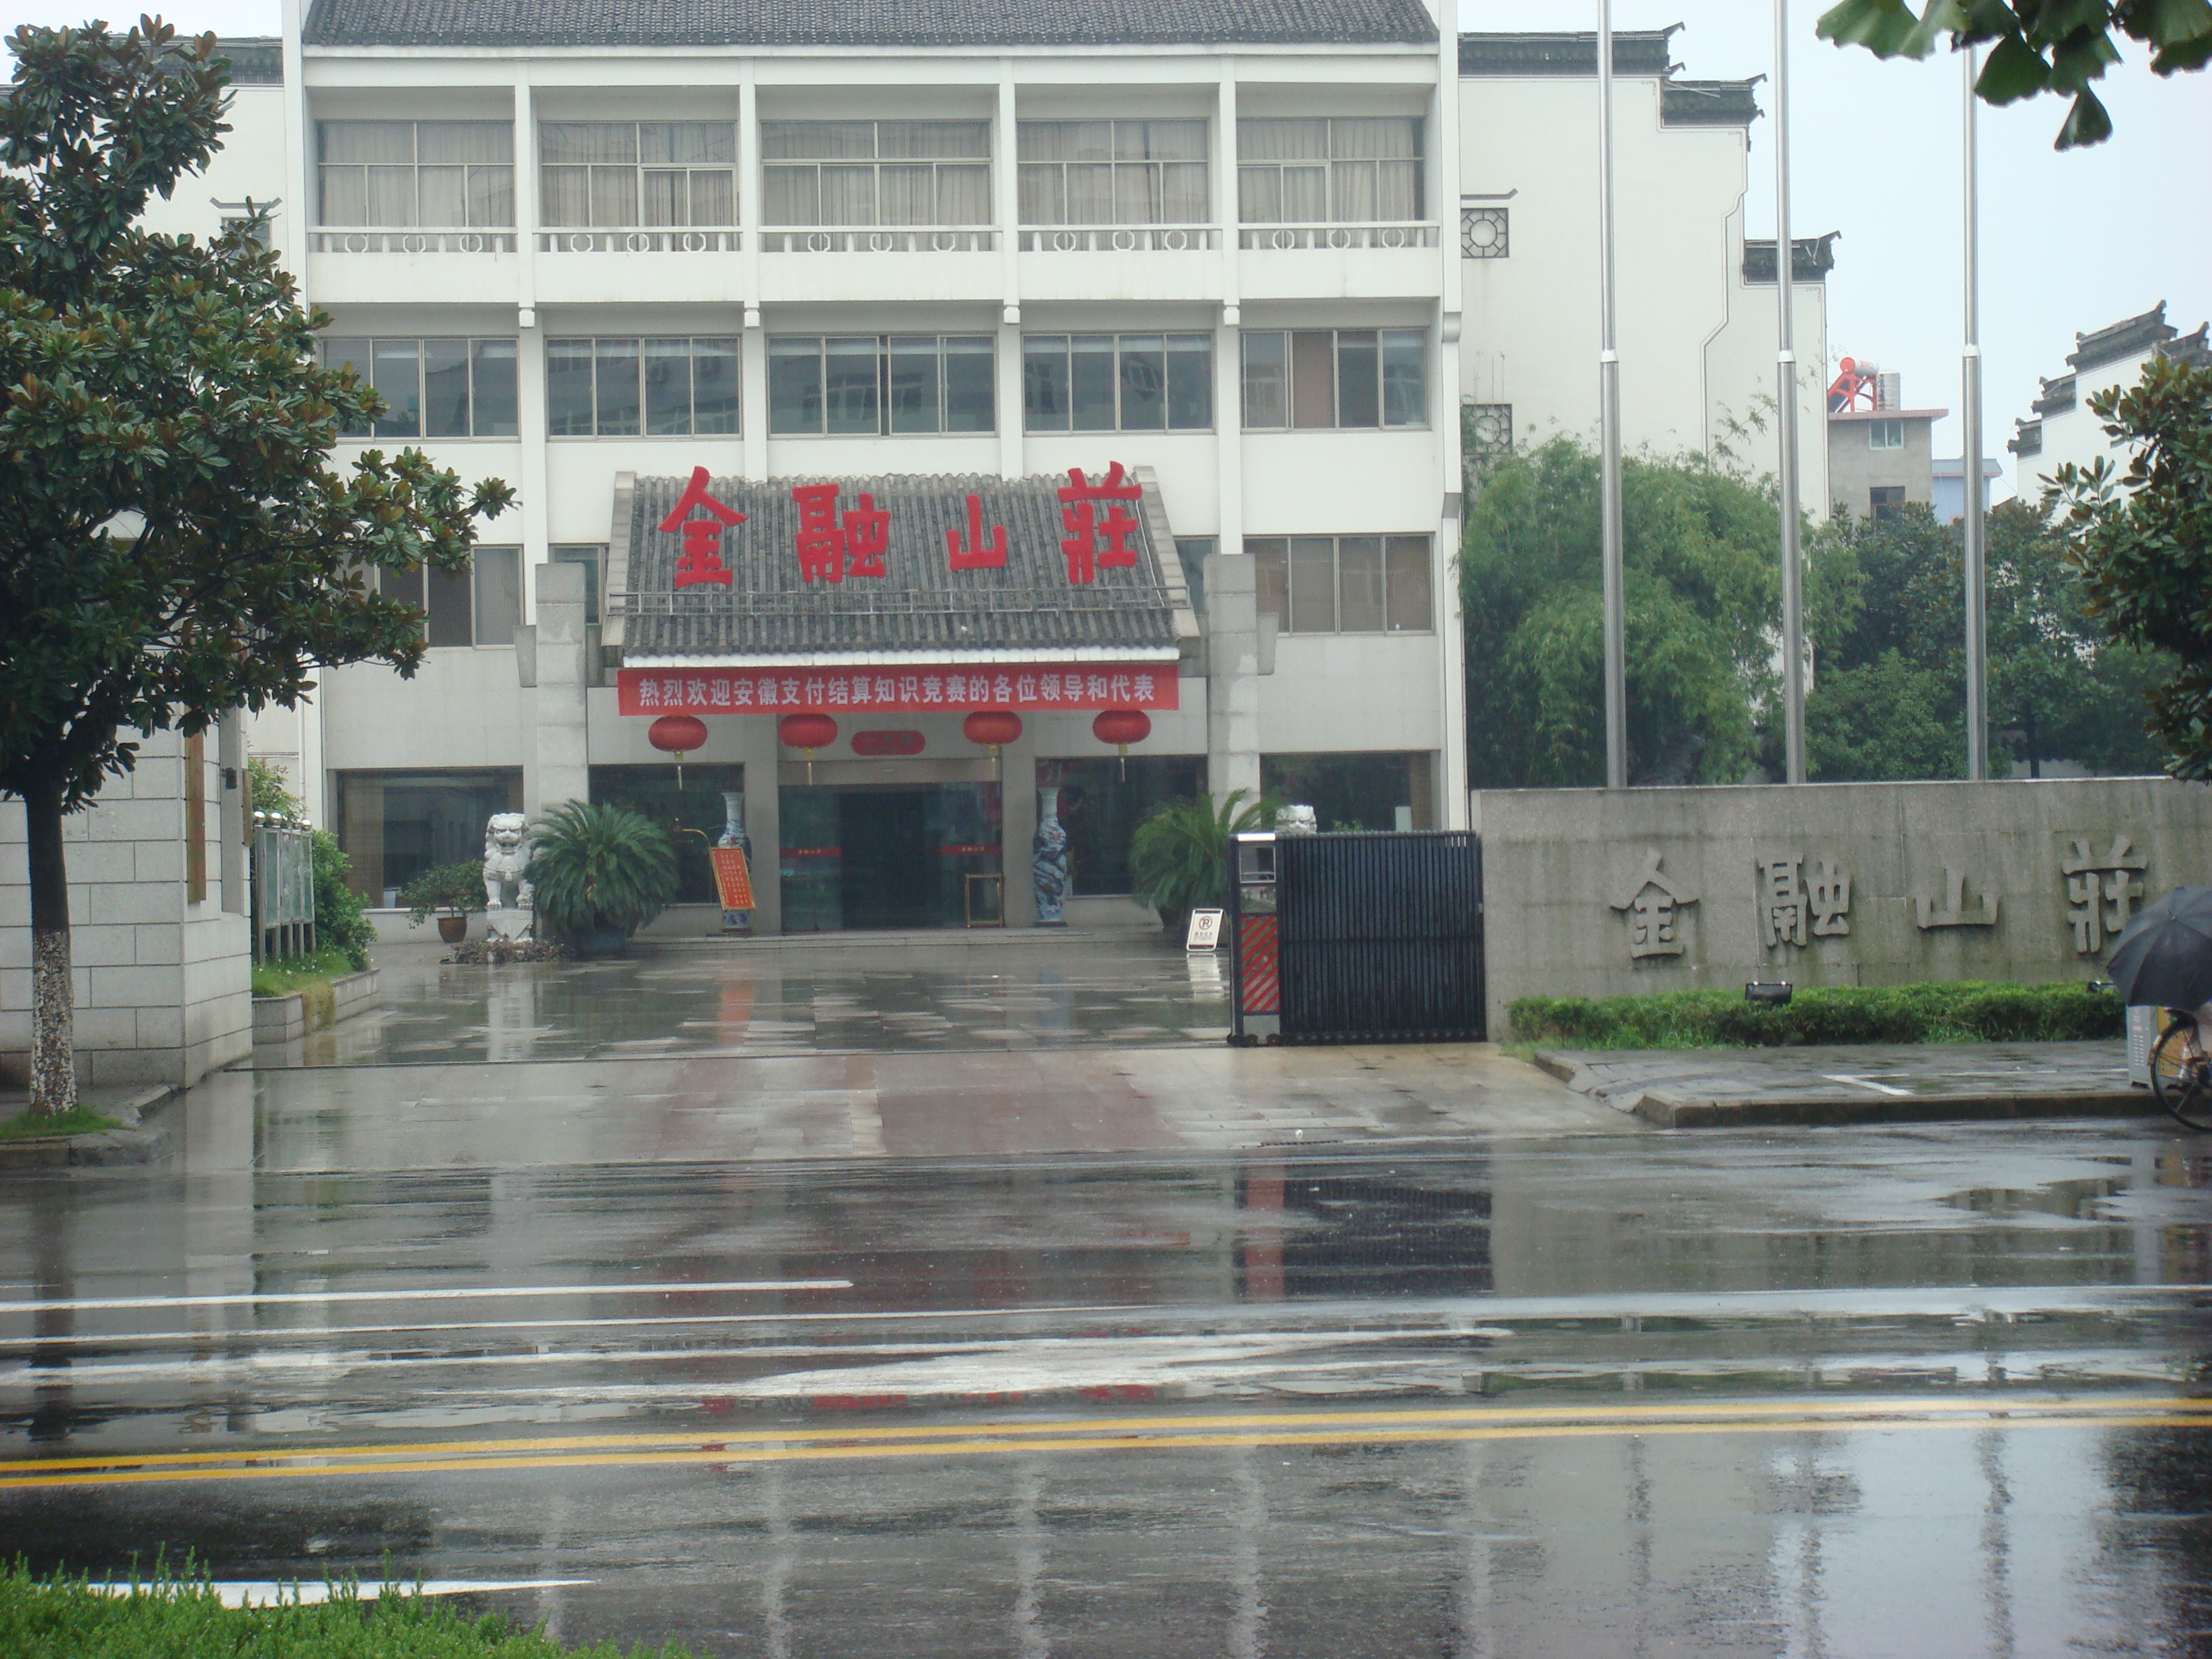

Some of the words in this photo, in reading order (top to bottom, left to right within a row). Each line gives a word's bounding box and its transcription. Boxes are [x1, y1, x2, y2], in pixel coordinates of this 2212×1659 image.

[639, 675, 1155, 707] 热烈欢迎安徽支付结算知识竞赛的各位领导和代表
